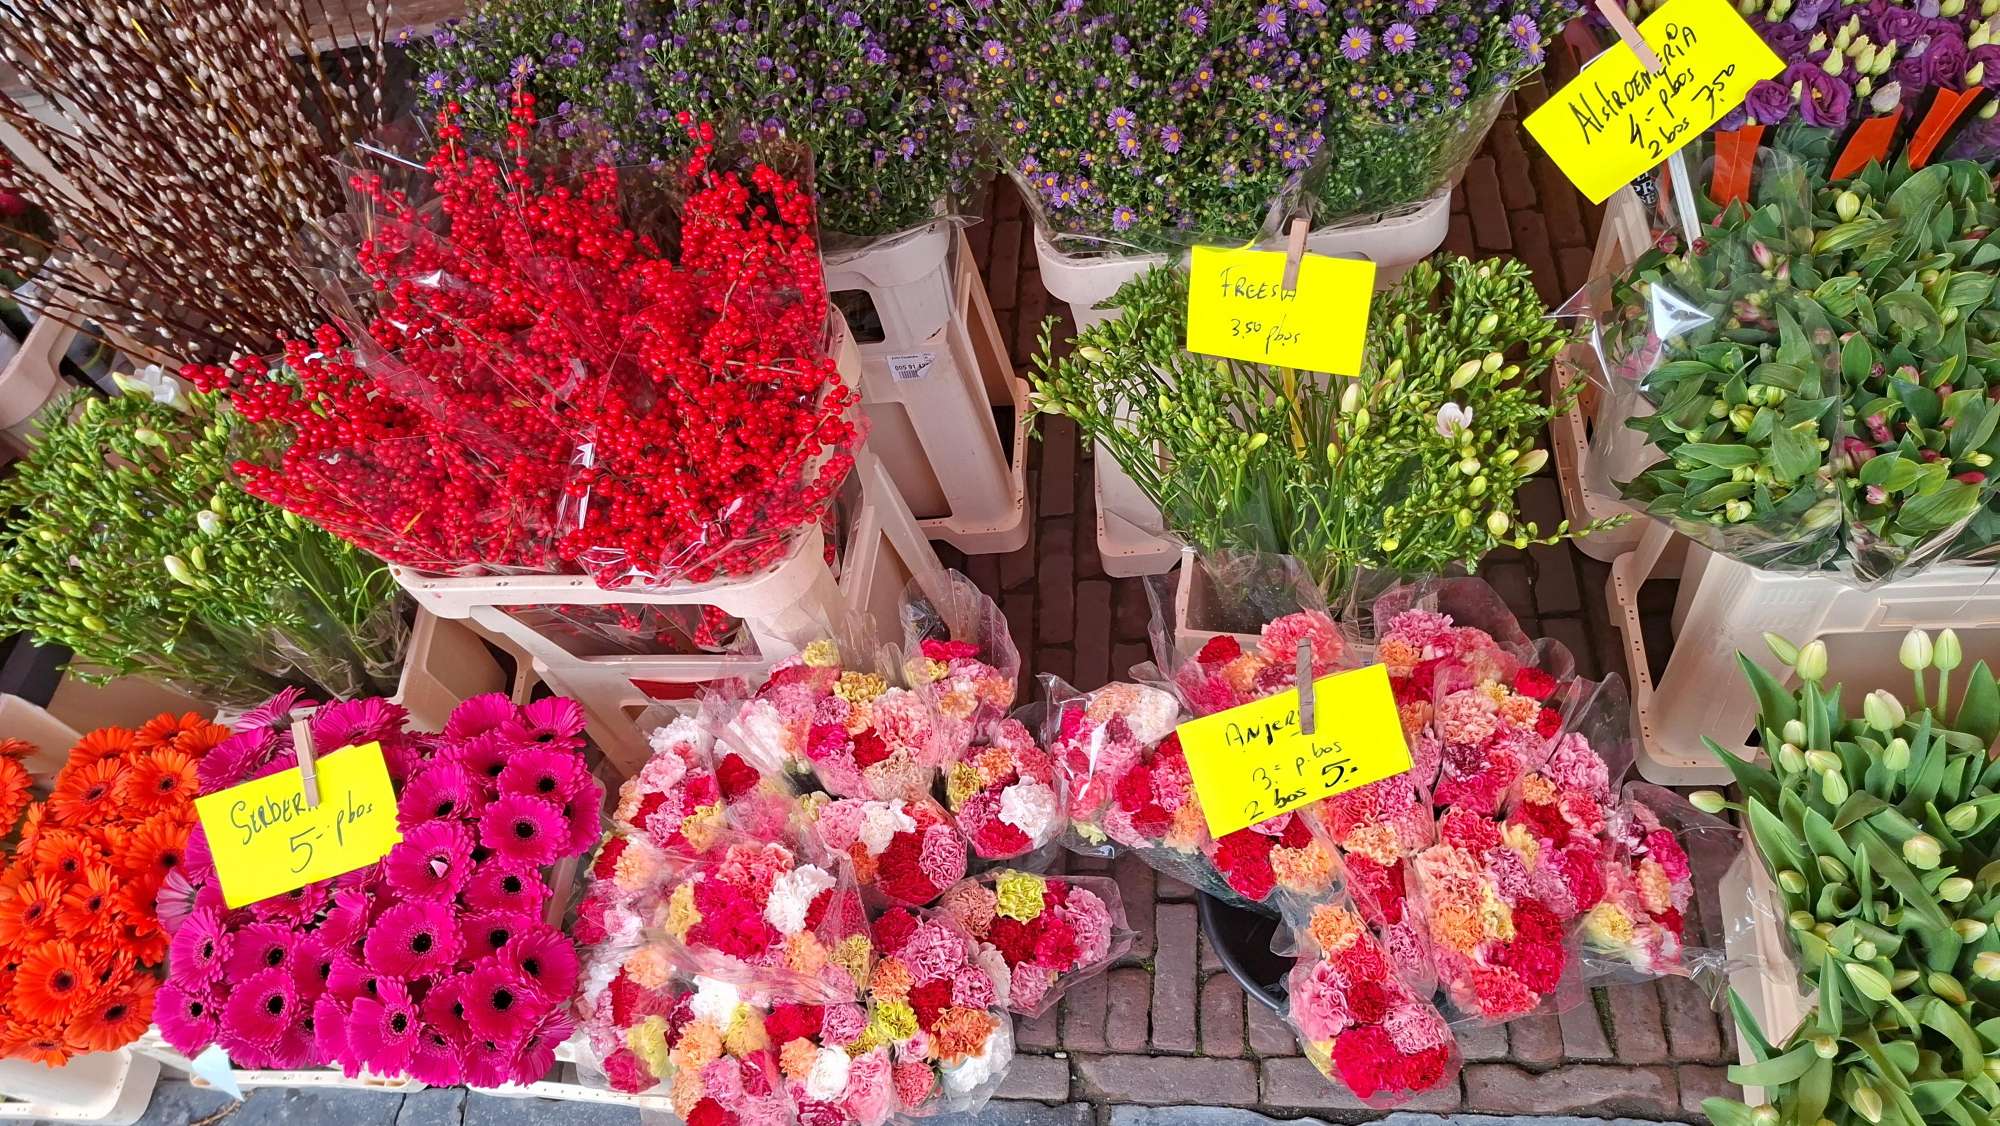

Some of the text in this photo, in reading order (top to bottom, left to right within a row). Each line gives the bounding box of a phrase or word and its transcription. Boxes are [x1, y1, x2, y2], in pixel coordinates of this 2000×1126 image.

[1648, 140, 1663, 159] 2
[1659, 117, 1690, 143] bos
[1312, 741, 1343, 758] bos
[1244, 800, 1264, 820] 2
[1274, 786, 1307, 808] bos
